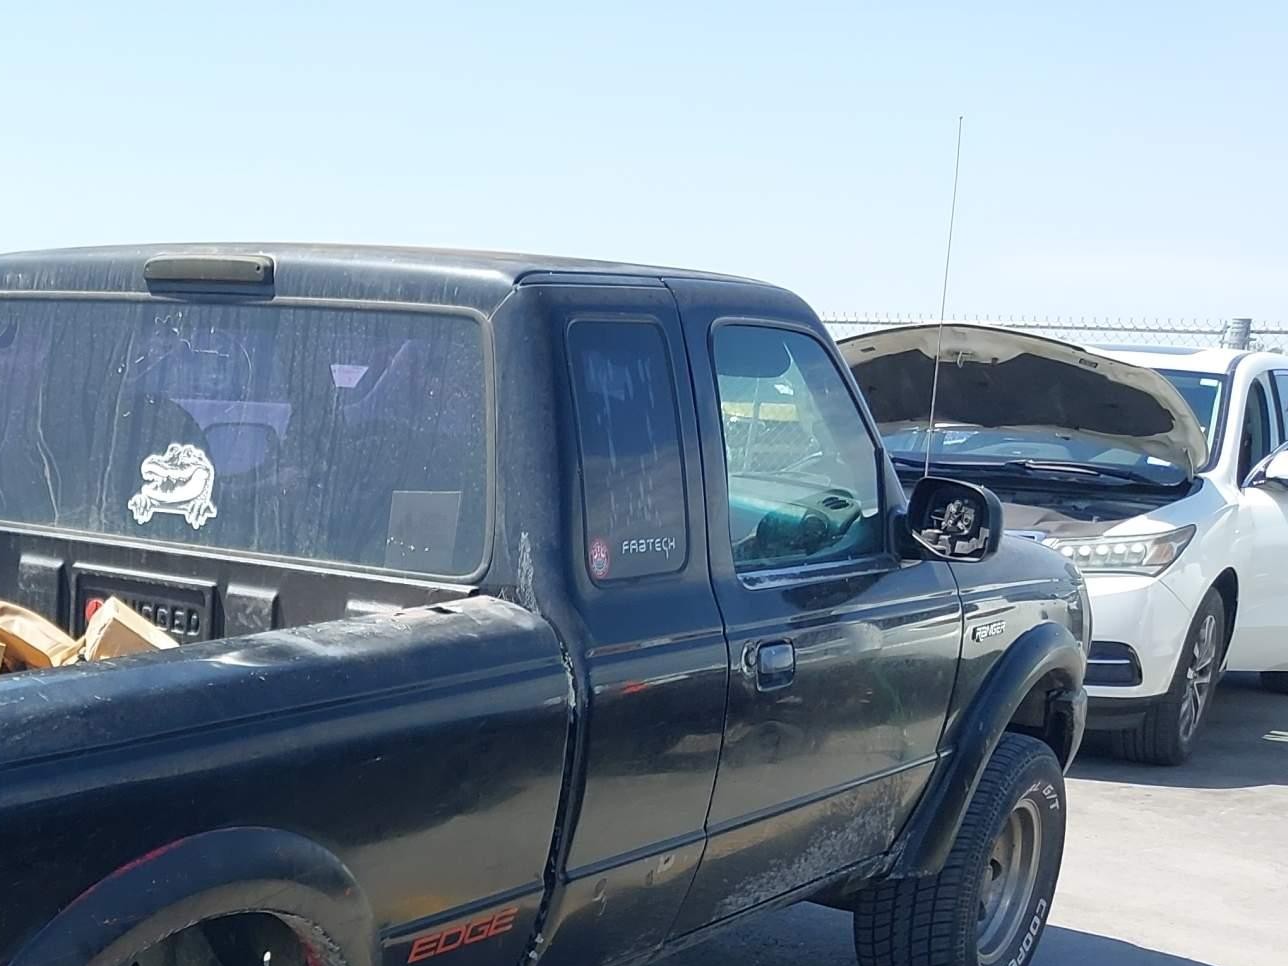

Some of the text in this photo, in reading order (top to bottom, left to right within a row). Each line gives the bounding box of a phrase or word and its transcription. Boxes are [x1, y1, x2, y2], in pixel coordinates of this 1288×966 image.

[622, 537, 675, 560] FABTECH
[975, 621, 1006, 641] RANGER
[1042, 783, 1061, 810] G/T
[408, 907, 519, 964] EDGE
